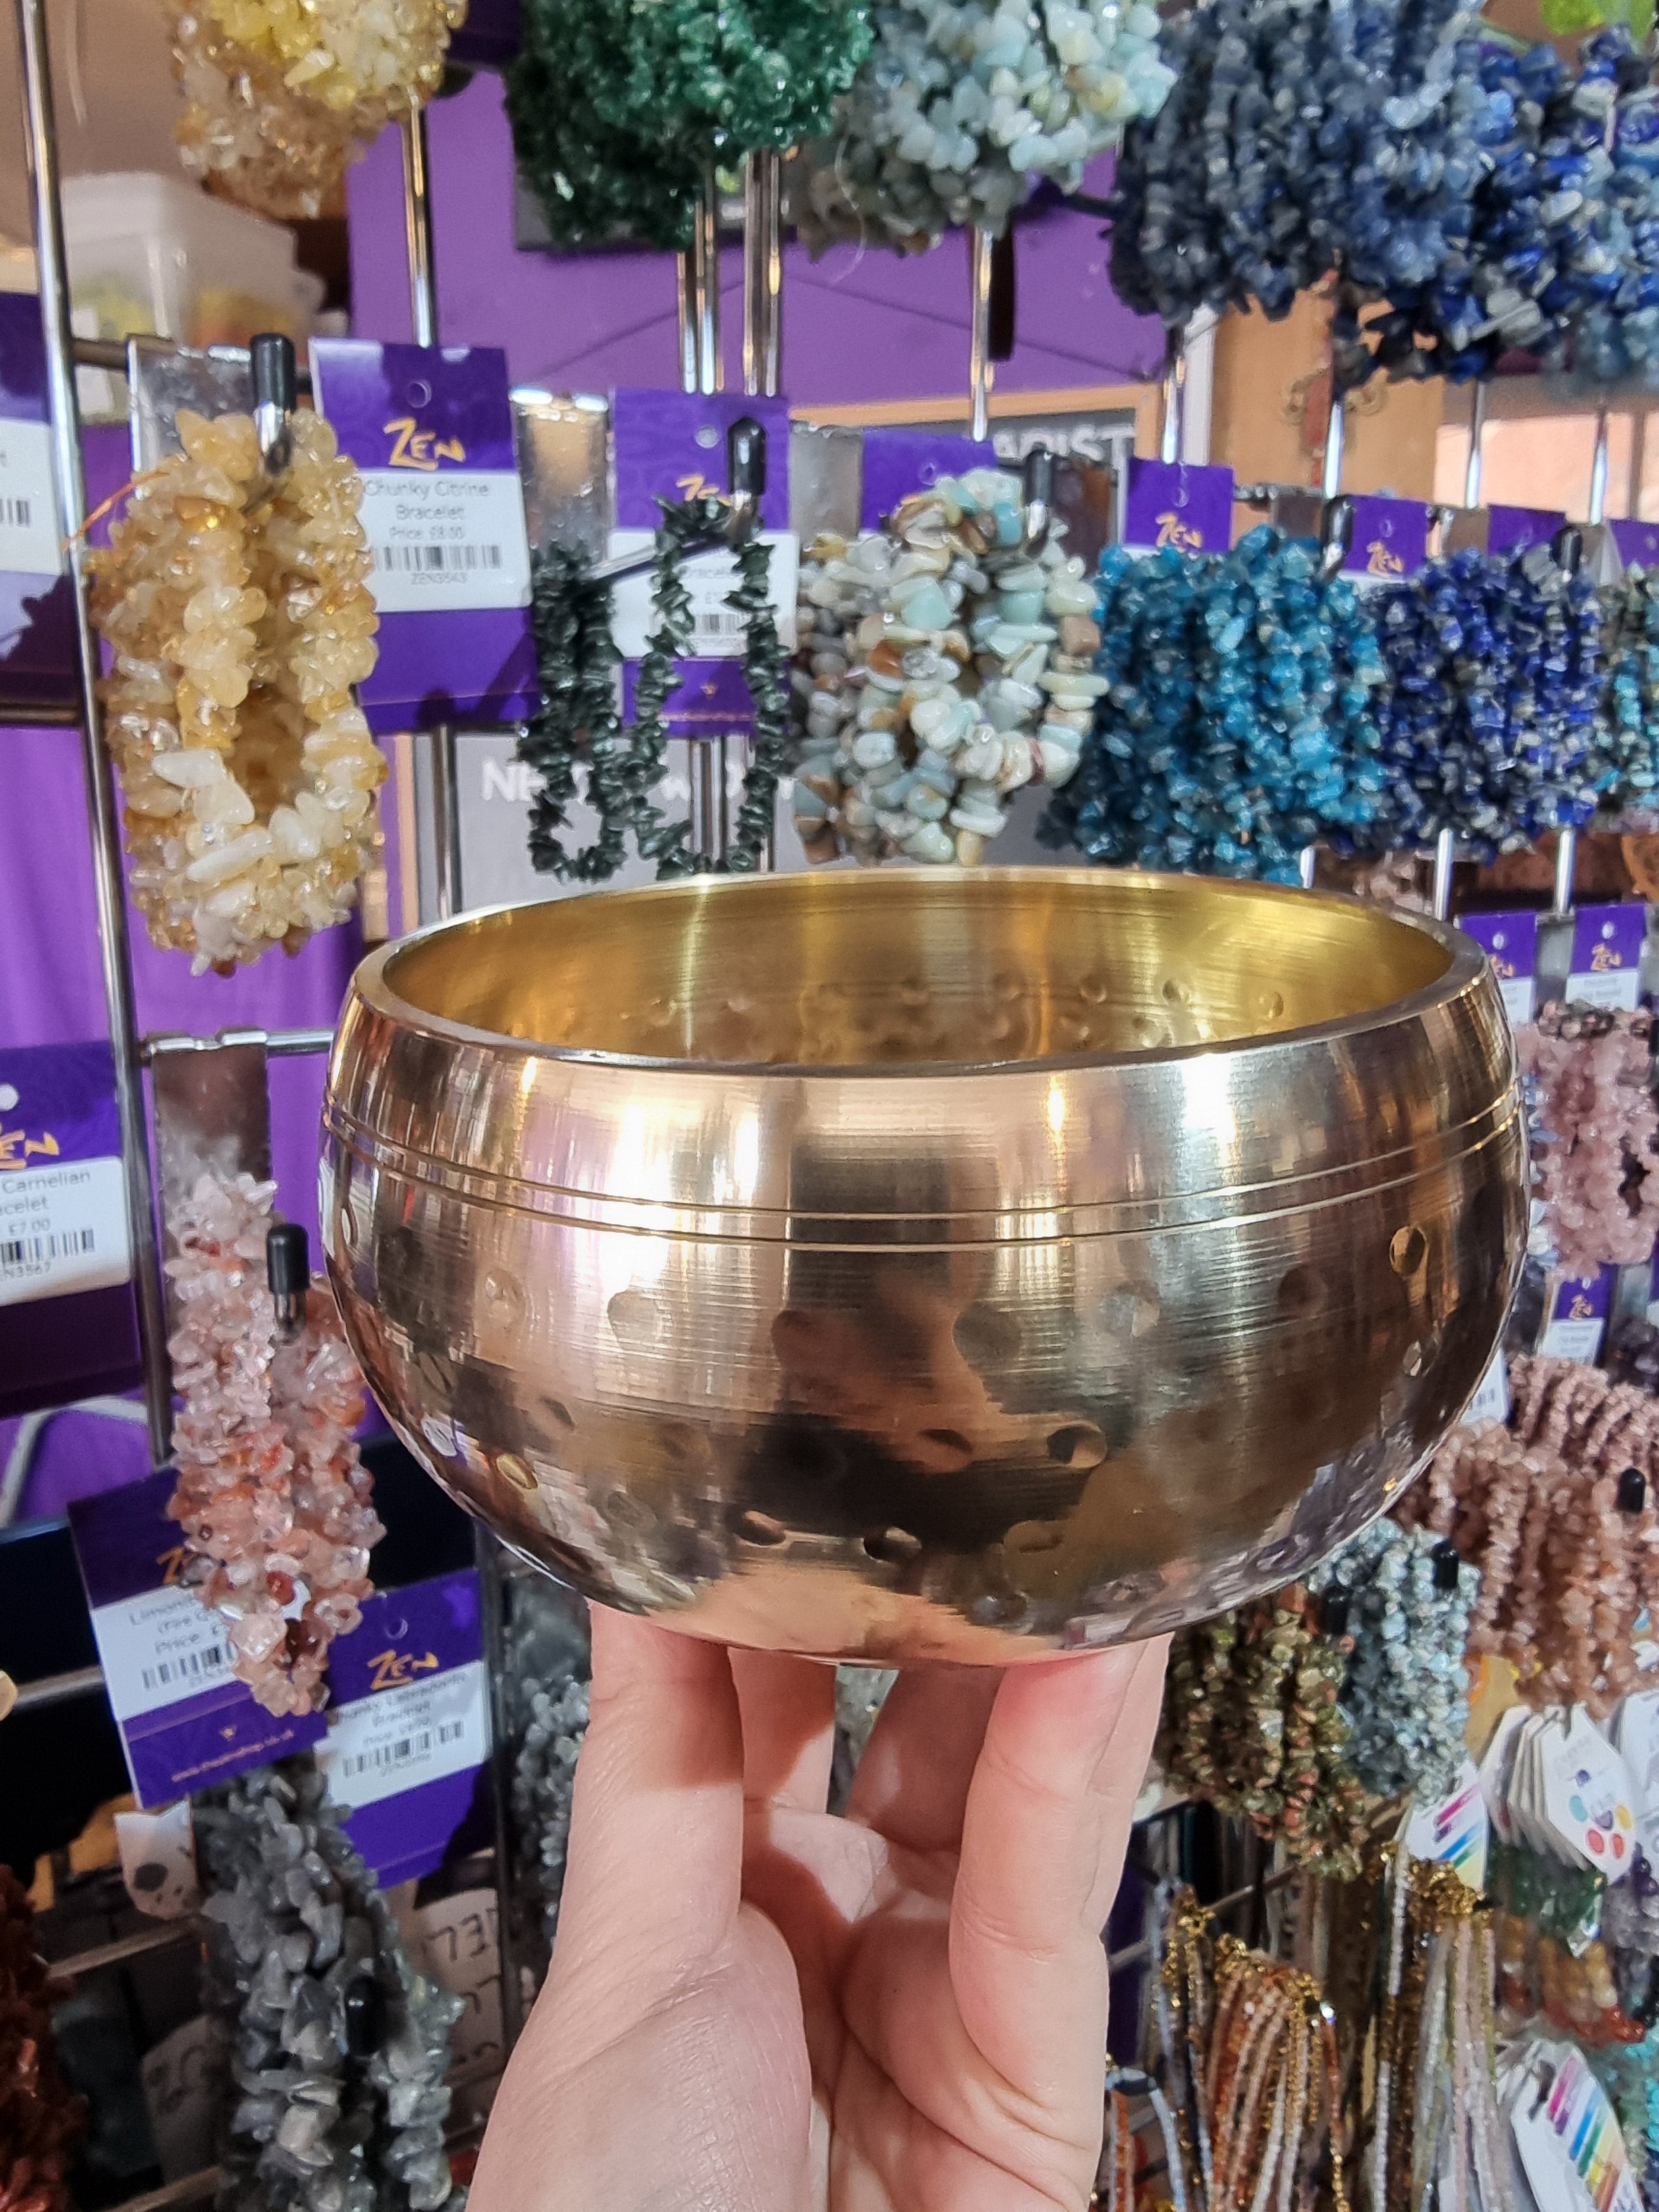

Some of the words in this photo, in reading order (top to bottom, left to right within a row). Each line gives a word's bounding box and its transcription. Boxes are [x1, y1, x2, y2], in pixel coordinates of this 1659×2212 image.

[383, 417, 466, 471] ZEN
[396, 504, 465, 520] Bracelet
[3, 1169, 91, 1193] Carnelian
[0, 1197, 50, 1215] celet
[367, 1648, 439, 1691] ZEN
